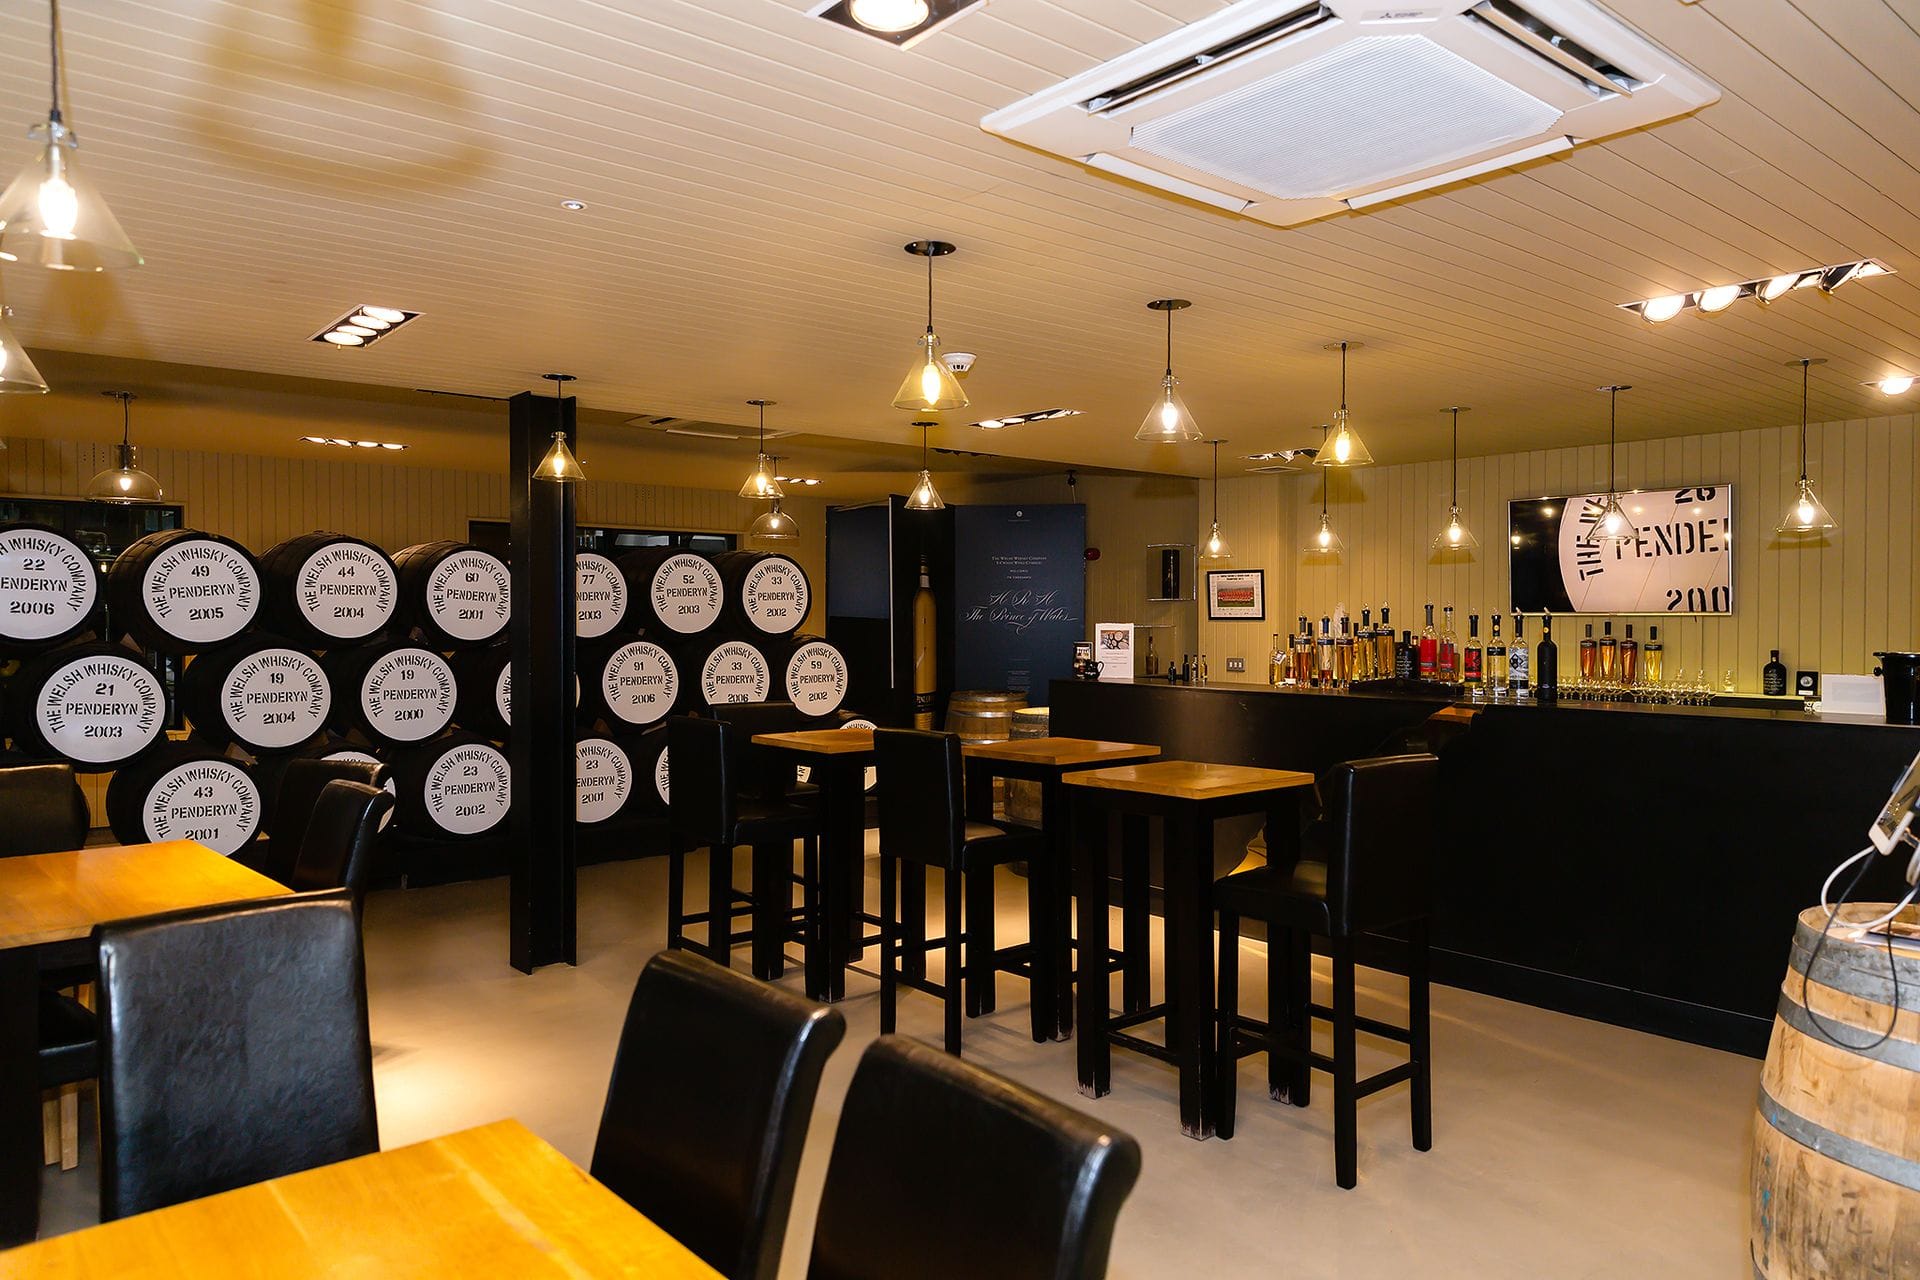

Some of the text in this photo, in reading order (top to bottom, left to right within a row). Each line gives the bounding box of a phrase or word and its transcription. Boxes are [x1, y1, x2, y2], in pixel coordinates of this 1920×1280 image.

[1616, 518, 1729, 560] PENDE
[23, 558, 45, 571] 22
[1576, 535, 1604, 581] THE
[8, 538, 65, 556] WHISKY
[62, 555, 87, 611] COMPANY
[191, 565, 210, 577] 49
[337, 566, 355, 577] 44
[465, 572, 480, 582] 60
[0, 577, 67, 592] ENDERYN
[151, 548, 251, 618] THE WELSH WHISKY COMPANY
[305, 550, 391, 613] THE WELSH WHISKY COMPANY
[582, 575, 595, 584] 77
[656, 558, 718, 612] THE WELSH WHISKY COMPANY
[682, 575, 695, 584] 52
[771, 576, 782, 585] 33
[169, 584, 235, 599] PENDERYN
[320, 584, 377, 596] PENDERYN
[433, 558, 509, 618] THE WELSH WHISKY COMPANY
[605, 571, 622, 615] COMPANY
[666, 587, 708, 598] PENDERYN
[748, 564, 804, 615] THE WELSH WHISKY COMPANY
[447, 588, 497, 602] PENDERYN
[576, 592, 611, 601] NDERYN
[757, 592, 795, 601] PENDERYN
[10, 601, 54, 615] 2006
[189, 607, 224, 620] 2005
[333, 607, 365, 618] 2004
[678, 605, 700, 615] 2003
[766, 608, 787, 617] 2002
[965, 605, 987, 621] The
[990, 607, 1024, 622] Prince
[1033, 606, 1078, 621] Wales
[458, 610, 484, 620] 2001
[578, 610, 602, 620] 2003
[634, 661, 645, 671] 91
[706, 646, 764, 698] THE WELSH WHISKY COMPANY
[731, 661, 742, 671] 33
[791, 646, 844, 698] THE WELSH WHISKY COMPANY
[811, 661, 822, 670] 59
[270, 672, 285, 684] 19
[401, 670, 415, 680] 19
[608, 645, 673, 702] THE WELSH WHISKY COMPANY
[716, 675, 755, 684] PENDERYN
[800, 674, 835, 684] PENDERYN
[368, 655, 450, 718] THE WELSH WHISKY COMPANY
[619, 676, 663, 686] PENDERYN
[95, 682, 115, 697] 21
[230, 655, 323, 723] THE WELSH WHISKY COMPANY
[383, 689, 437, 700] PENDERYN
[46, 663, 156, 734] THE WELSH WHISKY COMPANY
[246, 691, 308, 704] PENDERYN
[632, 694, 656, 704] 2006
[727, 693, 749, 703] 2006
[808, 691, 828, 702] 2002
[66, 703, 139, 716] PENDERYN
[395, 709, 424, 721] 2000
[263, 711, 296, 724] 2004
[84, 725, 123, 738] 2003
[463, 766, 478, 776] 23
[585, 760, 599, 770] 23
[579, 746, 626, 800] WHISKY COMPANY
[431, 750, 508, 813] THE WELSH WHISKY COMPANY
[576, 776, 615, 788] ENDERYN
[193, 786, 214, 798] 43
[444, 781, 496, 796] PENDERYN
[153, 768, 254, 839] THE WELSH WHISKY COMPANY
[582, 792, 604, 804] 2001
[171, 803, 237, 820] PENDERYN
[455, 804, 486, 817] 2002
[185, 828, 219, 841] 2001
